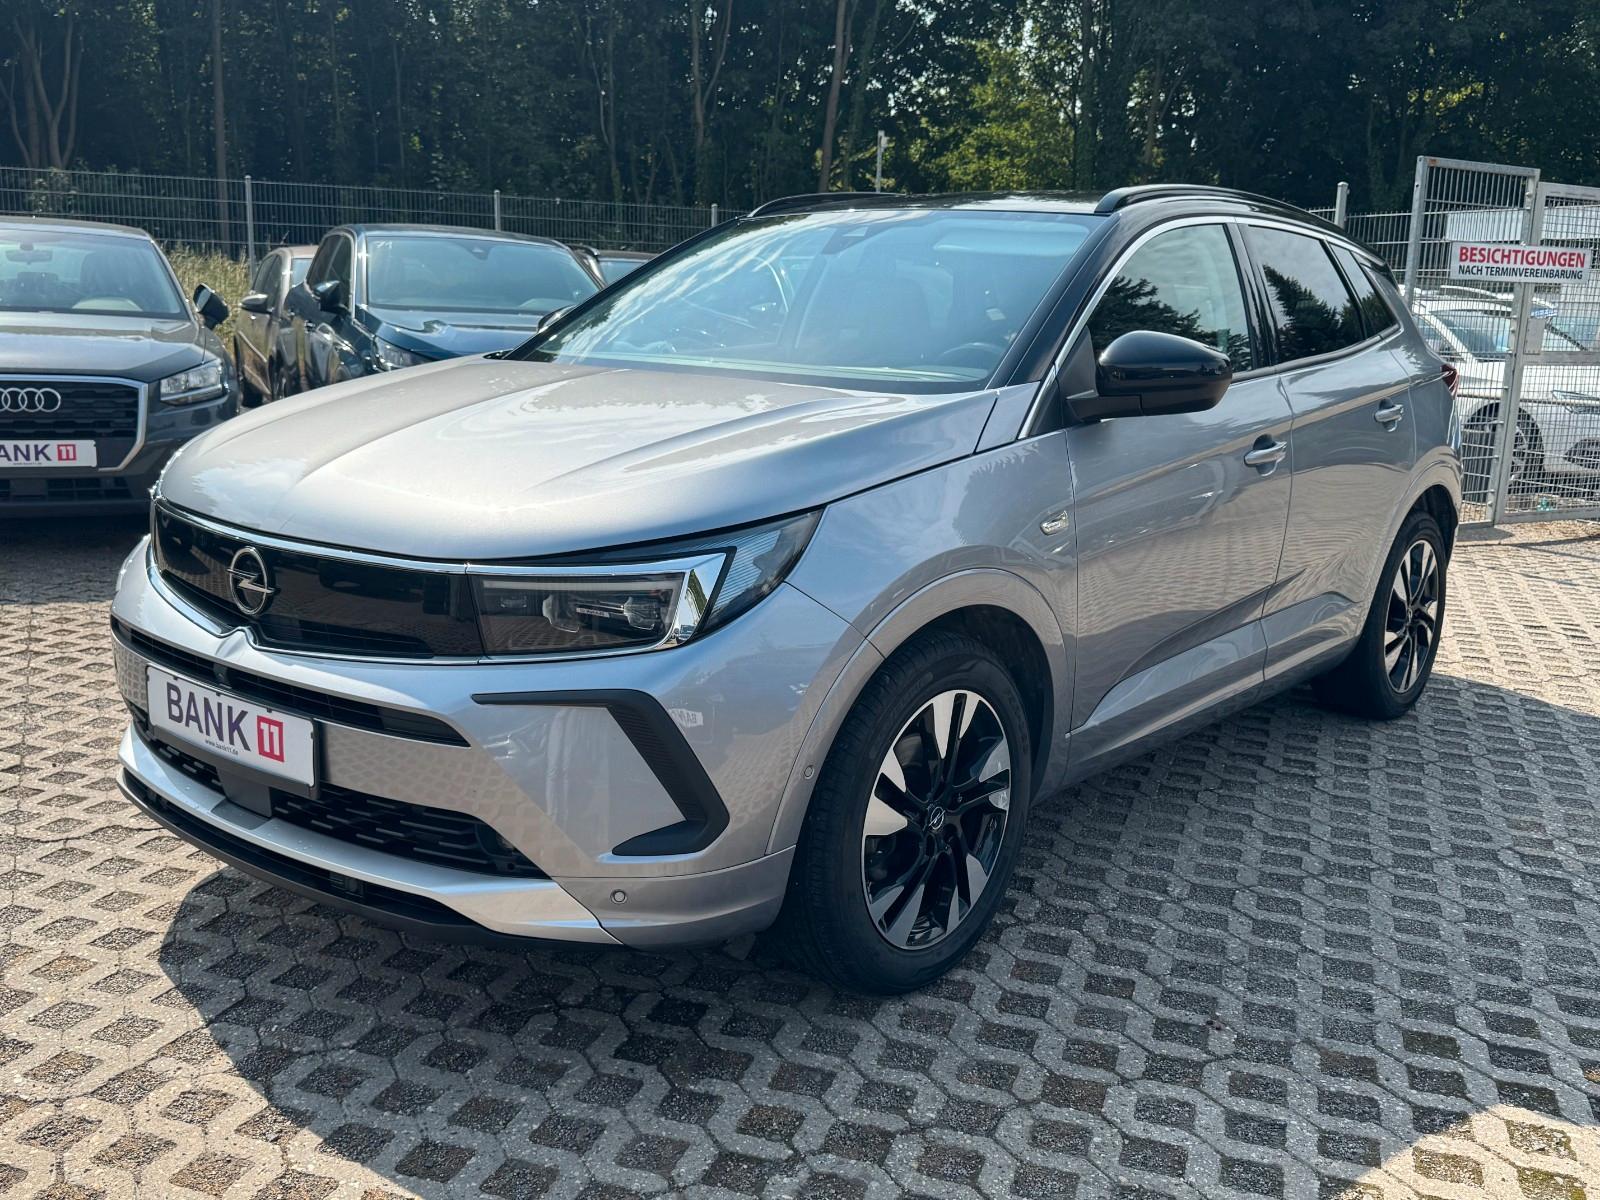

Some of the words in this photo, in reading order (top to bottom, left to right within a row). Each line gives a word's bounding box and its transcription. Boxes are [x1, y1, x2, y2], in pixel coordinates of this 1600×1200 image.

[1458, 246, 1586, 268] BESICHTIGUNGEN
[1458, 265, 1483, 276] NACH
[1485, 266, 1583, 280] TERMINVEREINBARUNG
[0, 444, 51, 461] ANK
[59, 445, 75, 460] 11
[166, 682, 251, 752] BANK
[260, 720, 281, 757] 11
